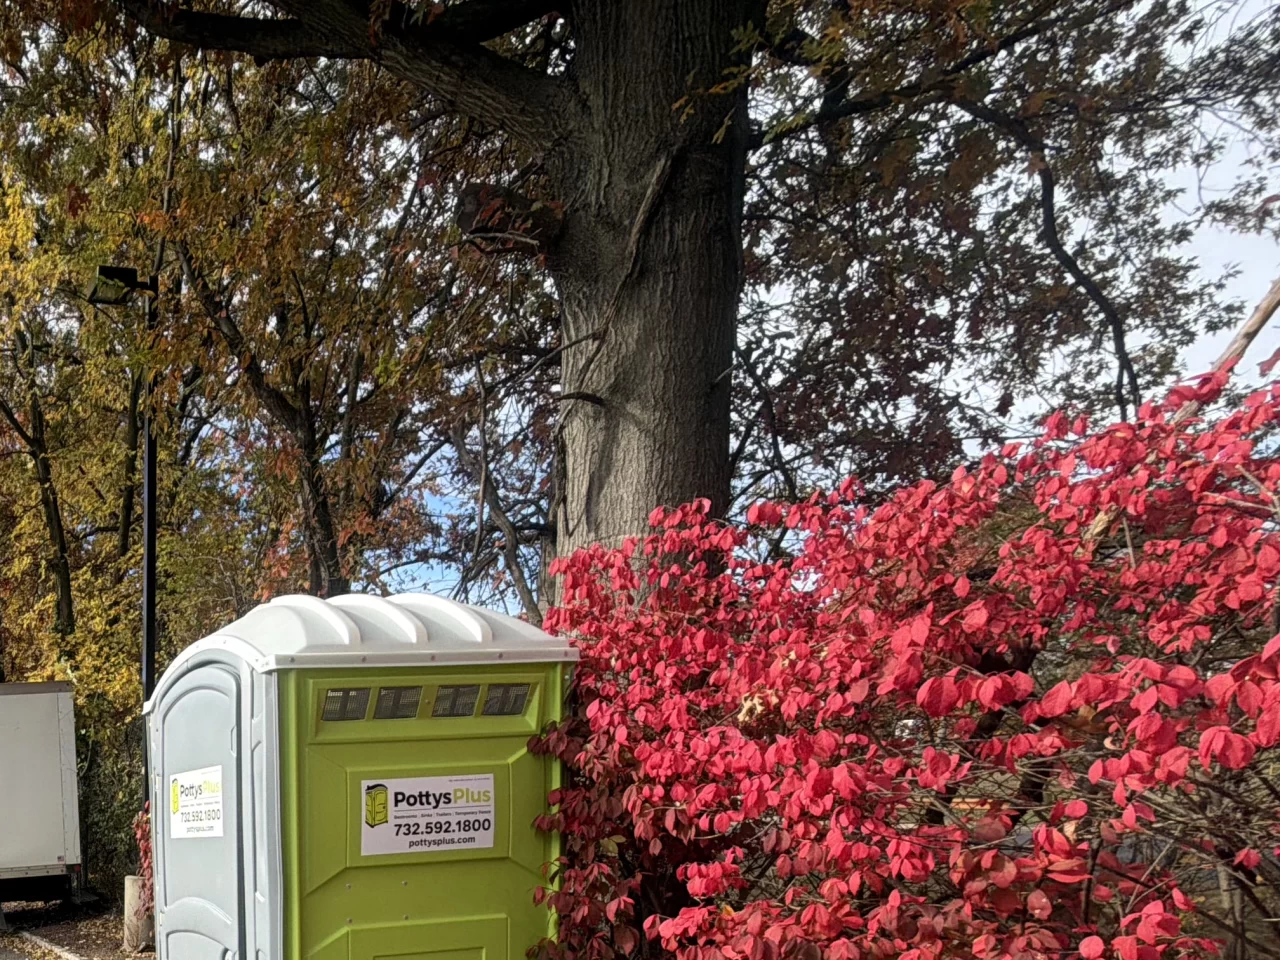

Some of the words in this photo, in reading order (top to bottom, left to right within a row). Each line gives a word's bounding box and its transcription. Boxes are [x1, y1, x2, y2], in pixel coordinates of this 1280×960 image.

[180, 780, 220, 799] PottysPlus
[394, 788, 491, 809] PottysPlus
[180, 809, 221, 823] 732.592.1800
[394, 818, 491, 837] 732.592.1800
[408, 836, 476, 849] pottysplus.com
